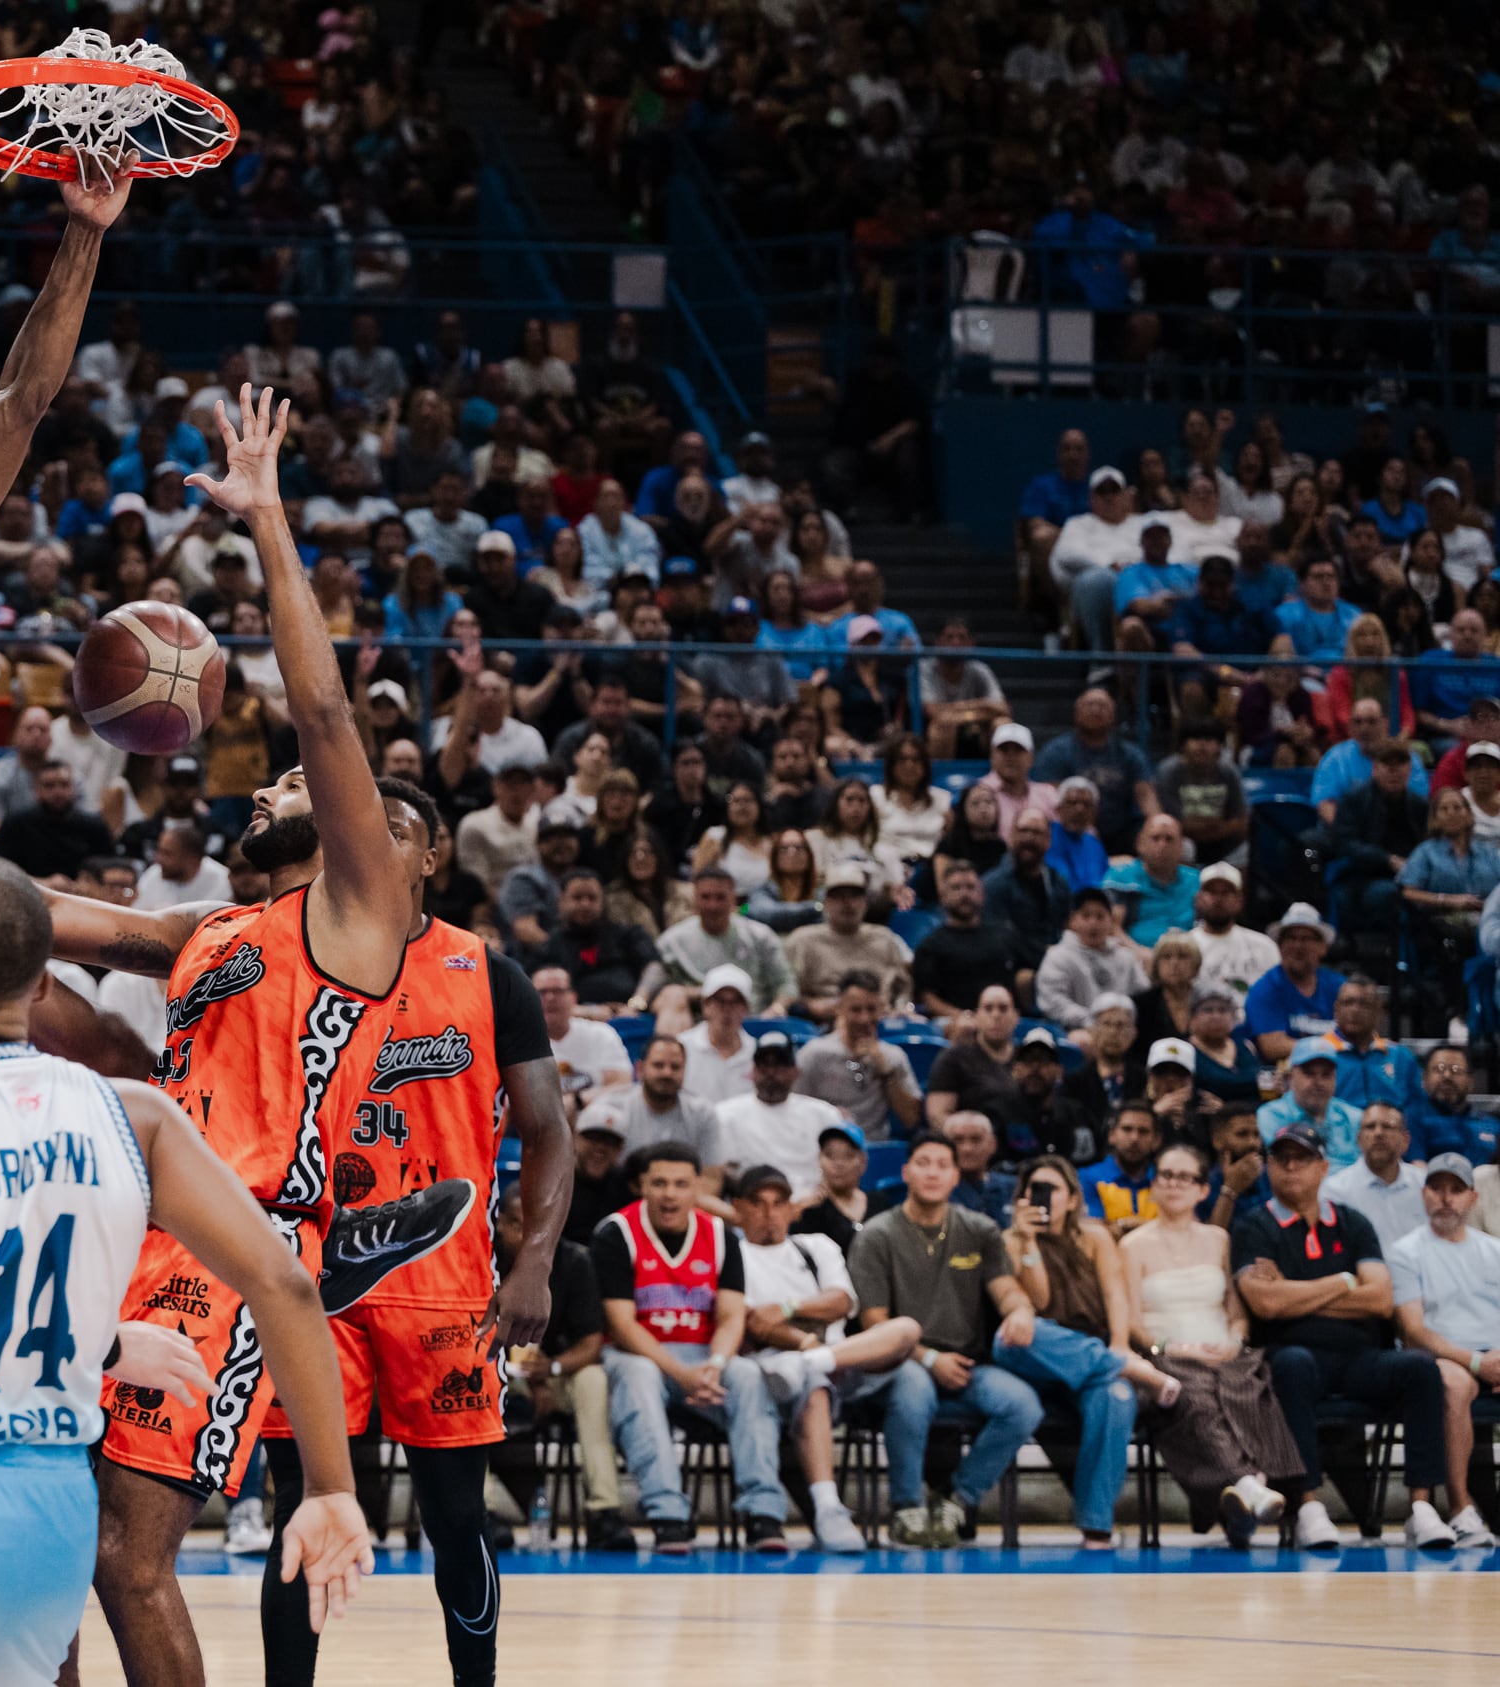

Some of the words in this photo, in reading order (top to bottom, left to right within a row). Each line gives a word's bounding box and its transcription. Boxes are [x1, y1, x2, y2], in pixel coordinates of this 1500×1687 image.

[374, 1025, 474, 1074] ermán
[352, 1100, 410, 1149] 34
[142, 1292, 212, 1318] aesars
[419, 1330, 472, 1347] TURISMO
